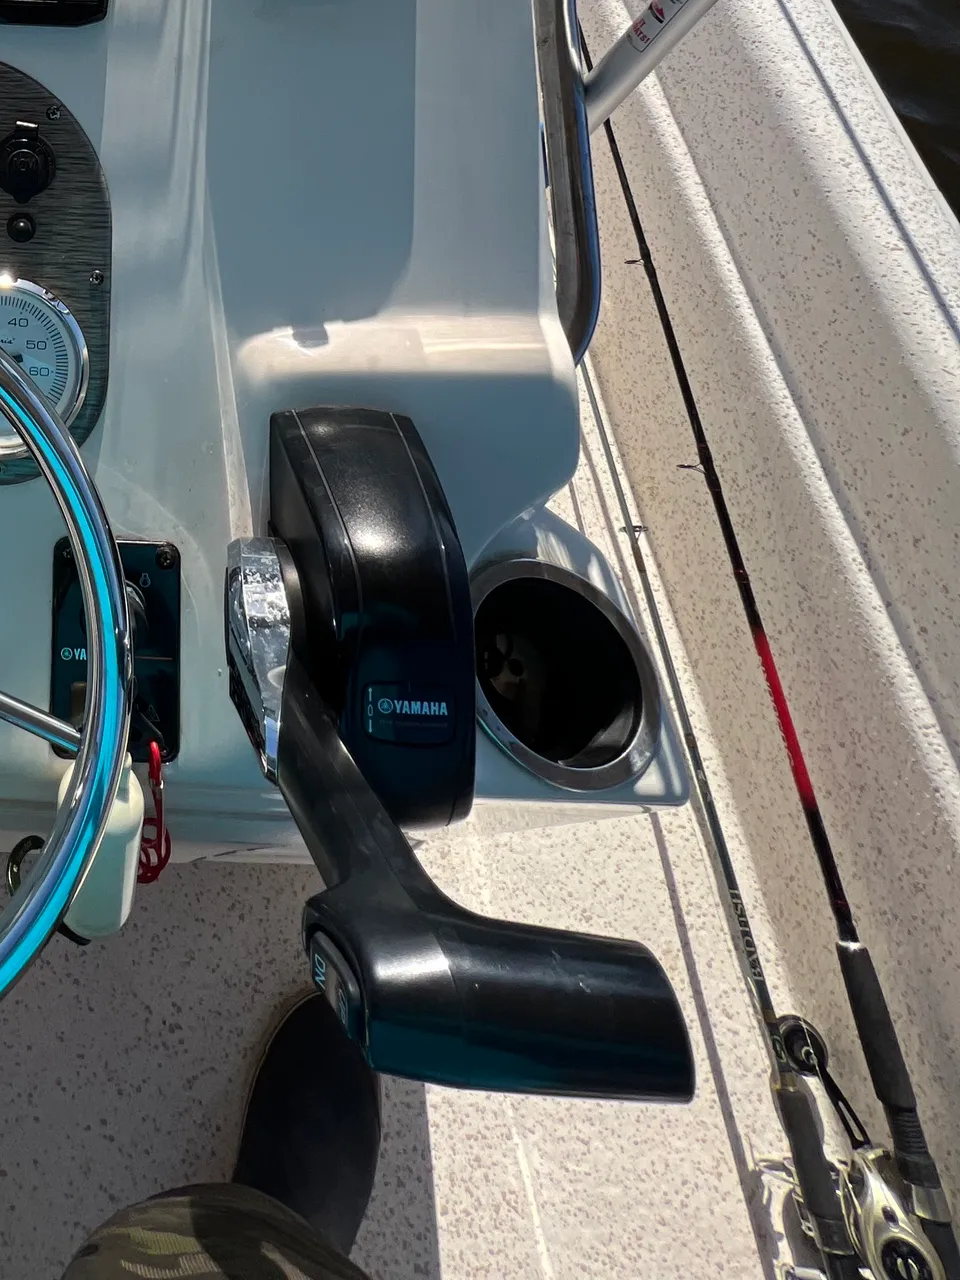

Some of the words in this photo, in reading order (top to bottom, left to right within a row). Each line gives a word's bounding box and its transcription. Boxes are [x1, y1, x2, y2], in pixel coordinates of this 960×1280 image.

[7, 317, 29, 328] 40
[25, 339, 47, 351] 50
[28, 366, 49, 377] 60
[393, 699, 448, 716] YAMAHA
